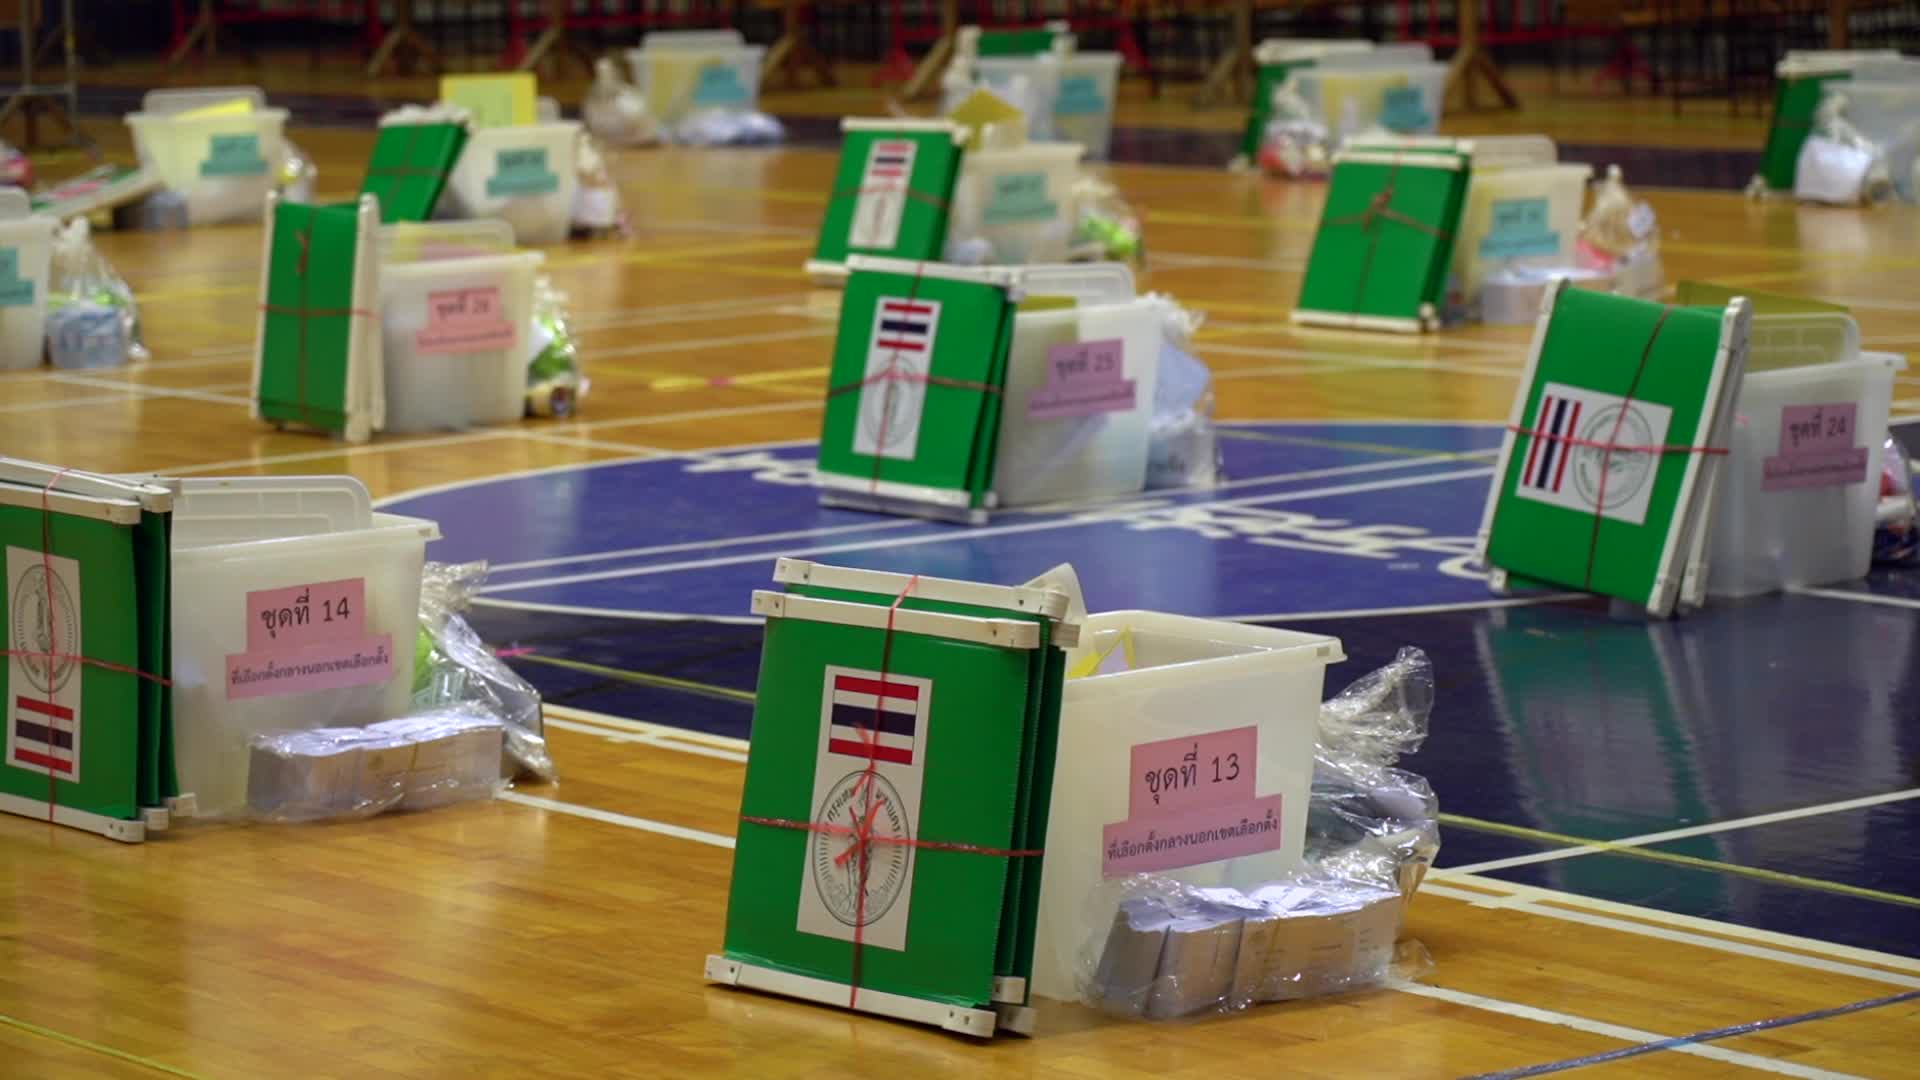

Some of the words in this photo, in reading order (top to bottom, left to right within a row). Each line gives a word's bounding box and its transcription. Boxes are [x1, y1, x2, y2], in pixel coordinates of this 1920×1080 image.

[1826, 415, 1848, 438] 24
[260, 587, 310, 639] ชุดที่
[322, 596, 350, 623] 14
[1145, 742, 1198, 805] ชุดที่
[1210, 752, 1241, 784] 13
[1107, 809, 1278, 861] ที่เลือกตั้งกลางนอกเขตเลือกตั้ง
